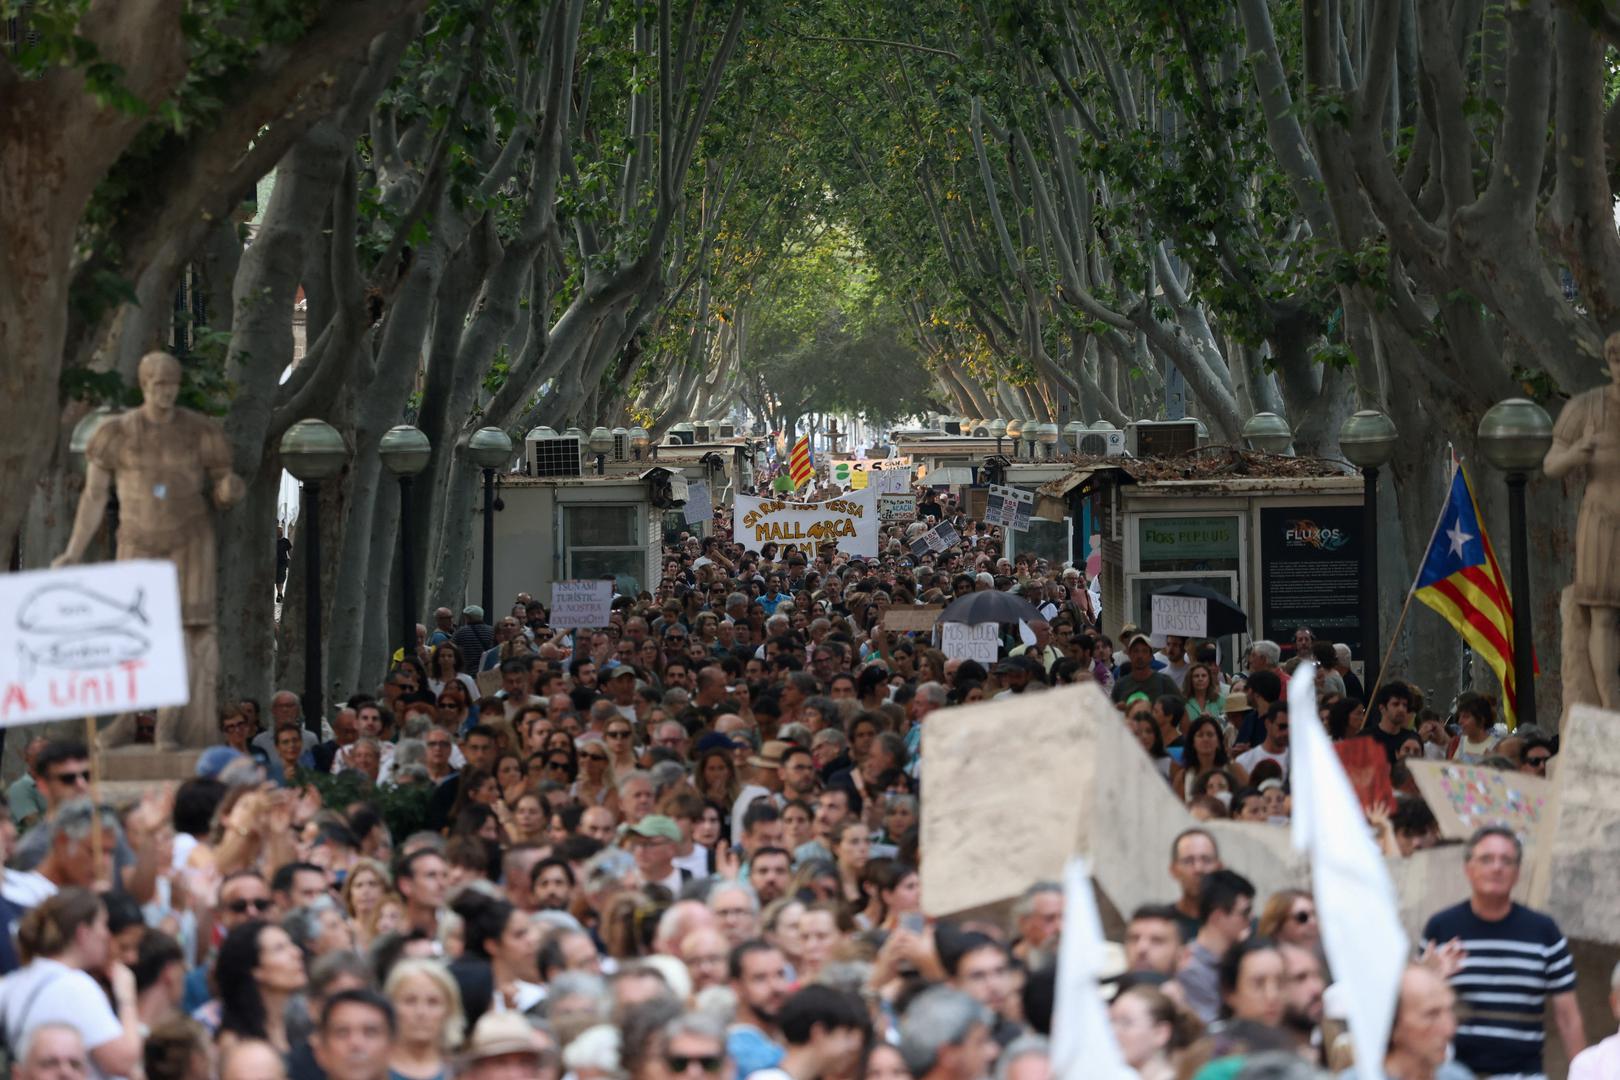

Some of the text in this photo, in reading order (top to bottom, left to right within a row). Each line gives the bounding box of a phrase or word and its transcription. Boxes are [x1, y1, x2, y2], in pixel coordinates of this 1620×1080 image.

[1285, 528, 1340, 541] FLUXOS
[1155, 614, 1201, 631] TURISTES
[945, 641, 991, 659] TURISTES
